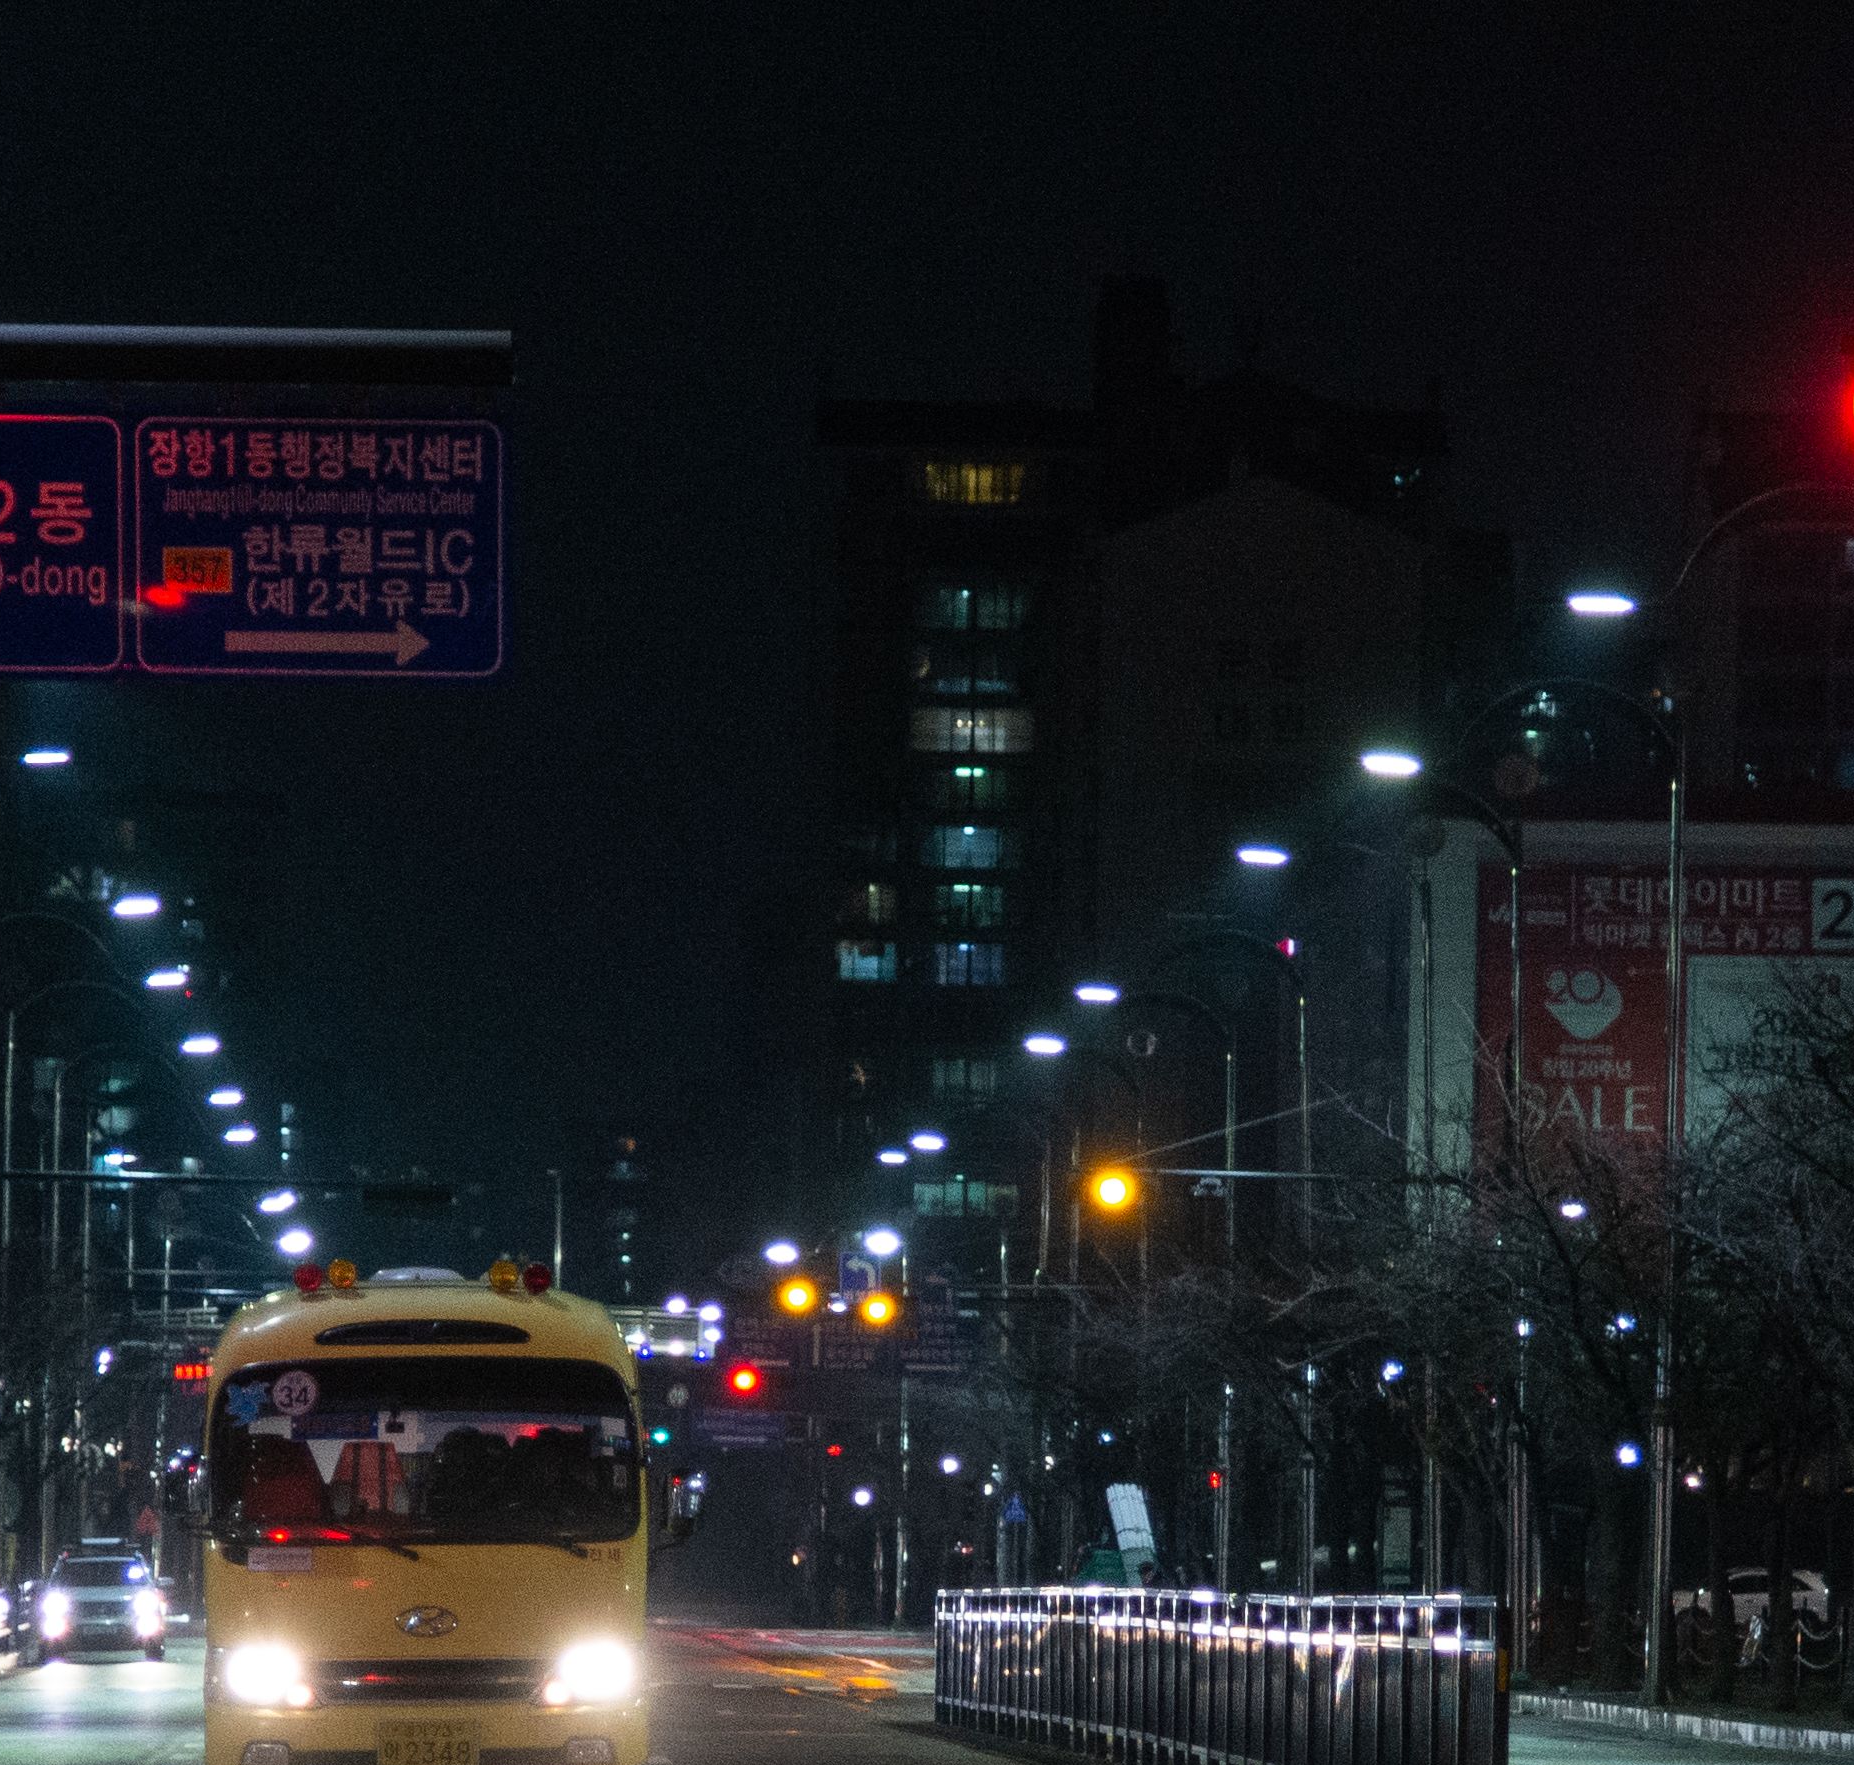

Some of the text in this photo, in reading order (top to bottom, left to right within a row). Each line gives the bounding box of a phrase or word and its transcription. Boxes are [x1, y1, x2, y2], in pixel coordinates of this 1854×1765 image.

[147, 427, 485, 484] 장항1동행정복지센터
[296, 484, 374, 520] Community
[375, 484, 427, 516] Service
[428, 485, 477, 516] Center
[241, 524, 476, 577] 한류월드IC
[278, 1384, 309, 1408] 34
